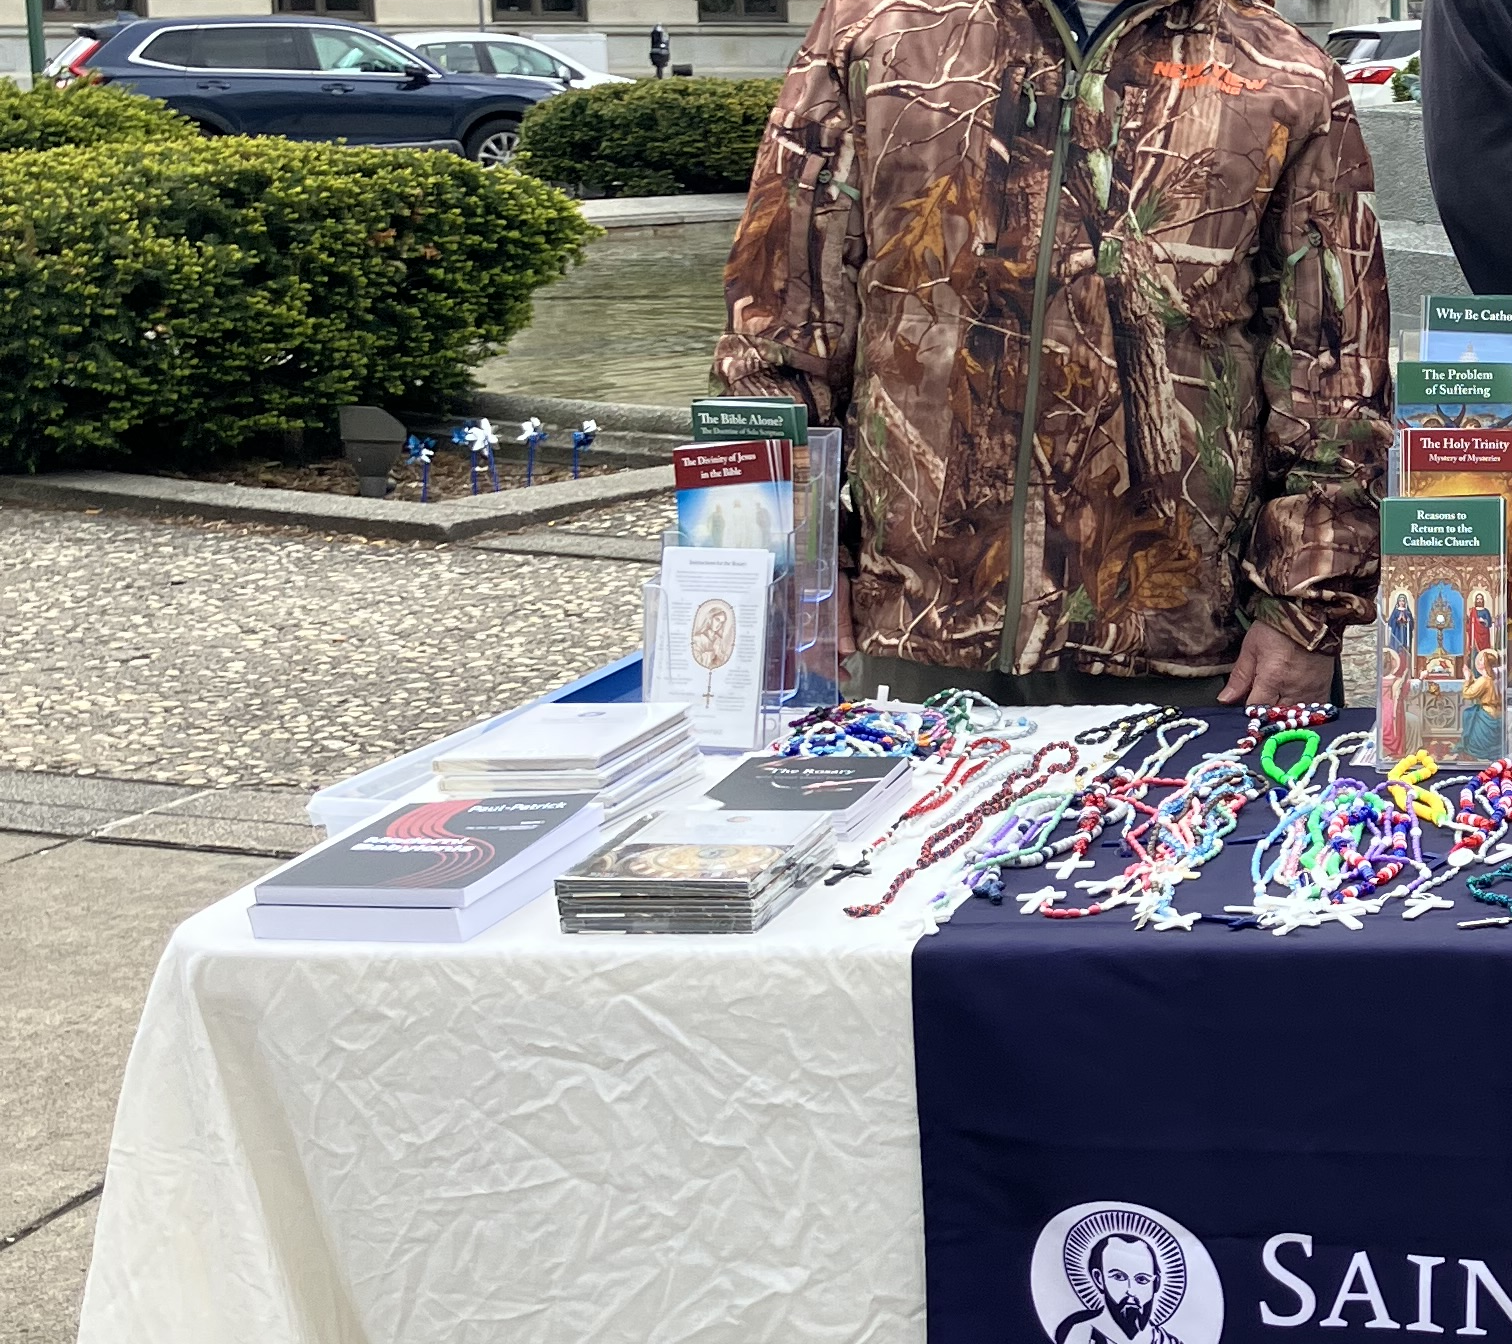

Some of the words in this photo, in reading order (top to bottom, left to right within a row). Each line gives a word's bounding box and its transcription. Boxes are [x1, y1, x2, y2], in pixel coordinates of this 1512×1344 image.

[1210, 63, 1268, 91] VIEW
[1436, 307, 1463, 323] Why
[1464, 309, 1479, 320] Be
[1422, 368, 1446, 380] The
[1447, 368, 1493, 380] Problem
[1425, 384, 1439, 395] of
[1439, 384, 1491, 398] Suffering
[698, 413, 719, 424] The
[720, 413, 747, 425] Bible
[748, 414, 783, 426] Alone?
[700, 427, 713, 435] The
[1420, 437, 1440, 449] The
[1443, 437, 1471, 452] Holy
[1472, 437, 1510, 452] Trinity
[681, 456, 697, 467] The
[698, 455, 727, 466] Divinity
[729, 453, 738, 463] of
[737, 452, 756, 463] Jesus
[1429, 454, 1457, 463] Mystery
[1458, 454, 1466, 462] of
[1466, 454, 1501, 464] Mysteries
[700, 471, 709, 479] in
[709, 469, 722, 478] the
[722, 467, 742, 477] Bible
[1416, 510, 1455, 520] Reasons
[1457, 512, 1467, 520] to
[1410, 523, 1445, 533] Return
[1446, 525, 1456, 533] to
[1457, 523, 1473, 533] the
[1402, 536, 1443, 547] Catholic
[1444, 536, 1480, 547] Church
[802, 767, 856, 776] Rosary
[468, 801, 567, 813] Paul-Patrick
